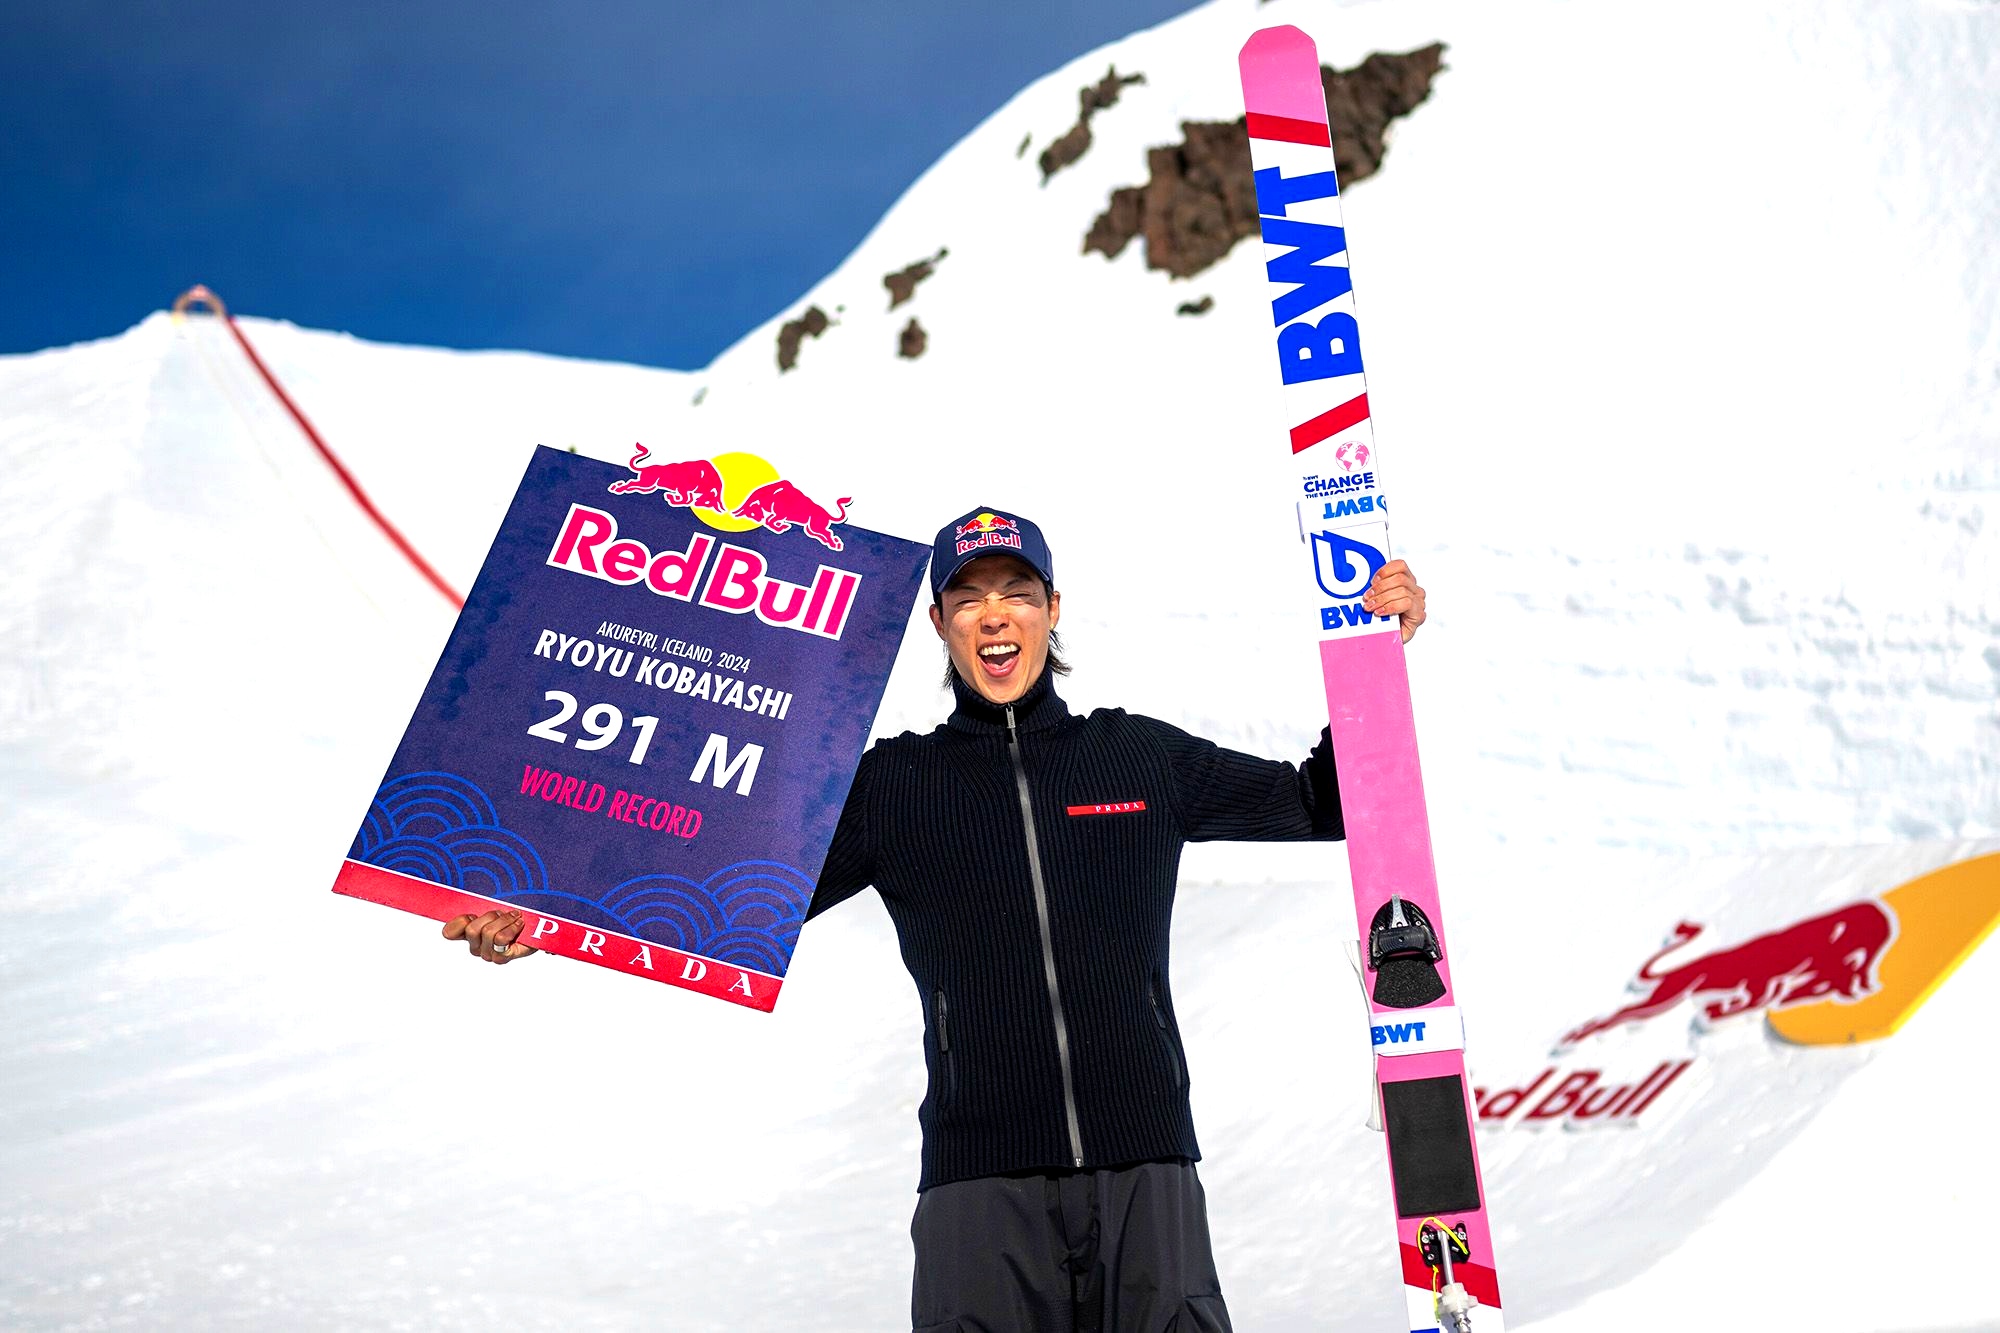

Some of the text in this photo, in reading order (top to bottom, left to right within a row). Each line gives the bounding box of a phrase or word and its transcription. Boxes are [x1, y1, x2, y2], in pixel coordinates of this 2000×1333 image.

[1253, 166, 1364, 386] BWT
[1303, 471, 1375, 493] CHANGE
[1322, 495, 1375, 520] BWT
[549, 505, 860, 638] Red Bull
[957, 532, 1021, 555] Red Bull
[1320, 602, 1391, 631] BW
[533, 628, 794, 721] RYOYU KOBAYASHI
[595, 620, 751, 674] AKUREYRI, ICELAND, 2024
[526, 690, 765, 797] 291 M
[519, 764, 703, 839] WORLD RECORD
[1095, 802, 1139, 813] PRADA
[530, 917, 754, 998] PRADA
[1371, 1021, 1426, 1046] BWT
[1522, 1059, 1693, 1121] Bull
